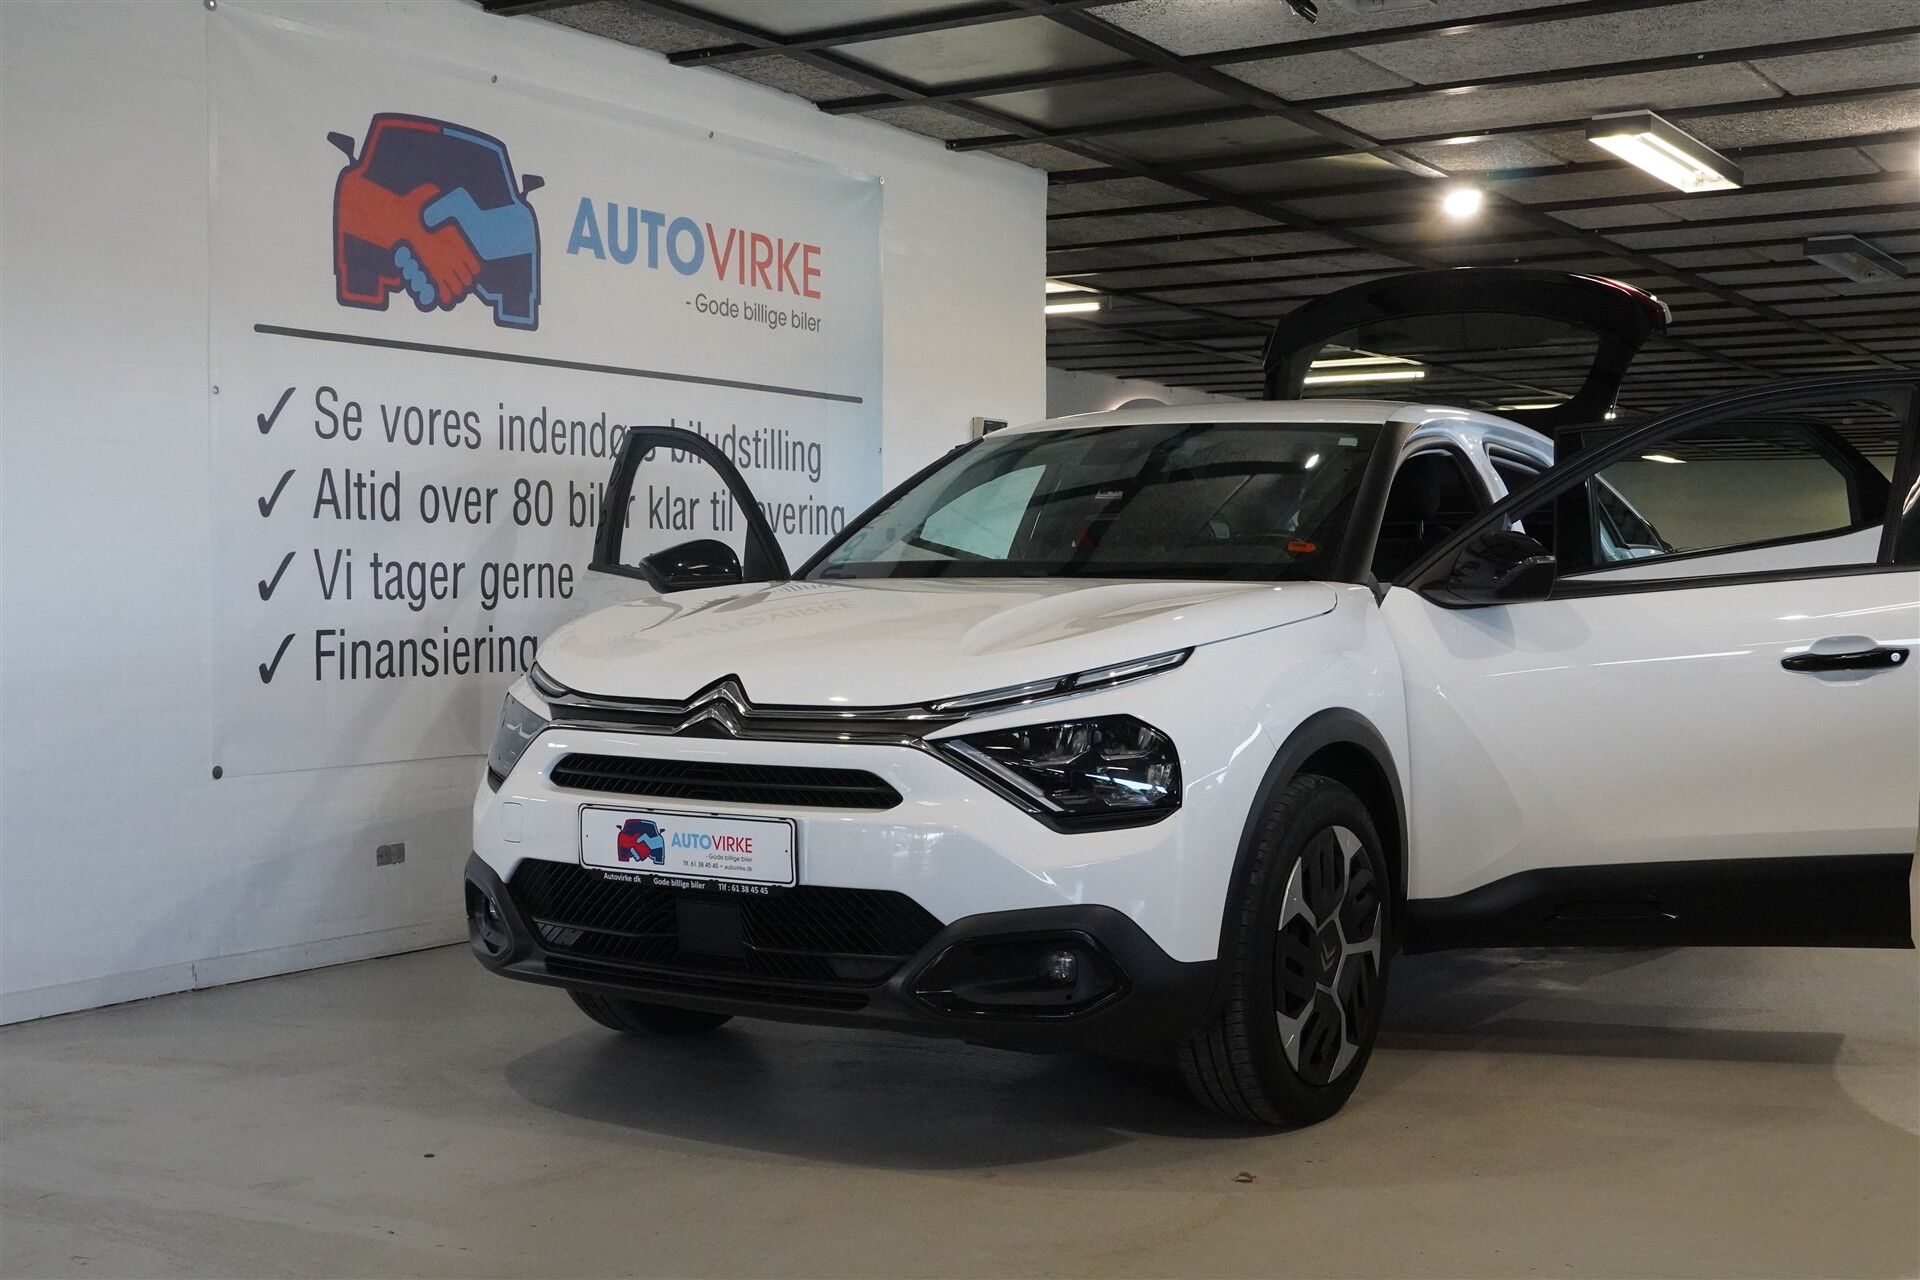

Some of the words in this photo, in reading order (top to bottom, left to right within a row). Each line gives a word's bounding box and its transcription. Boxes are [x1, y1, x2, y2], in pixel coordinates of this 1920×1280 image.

[566, 197, 821, 300] AUTOVIRKE
[695, 292, 739, 318] Gode
[743, 301, 788, 330] billige
[791, 309, 822, 333] biler
[314, 386, 362, 441] Se
[380, 404, 482, 450] vores
[312, 467, 401, 522] Altid
[419, 484, 499, 525] over
[512, 478, 553, 527] 80
[648, 485, 700, 531] klar
[710, 488, 734, 532] til
[313, 548, 352, 600] Vi
[370, 552, 466, 612] tager
[480, 562, 575, 611] gerne
[315, 624, 538, 681] Finansiering
[671, 832, 753, 854] AUTOVIRKE
[603, 872, 632, 882] Autovirke
[633, 875, 642, 883] dk
[653, 877, 670, 886] Gode
[670, 879, 690, 889] billige
[690, 880, 705, 889] biler
[731, 884, 740, 892] 61
[741, 885, 749, 893] 38
[750, 886, 759, 894] 45
[759, 887, 769, 895] 45
